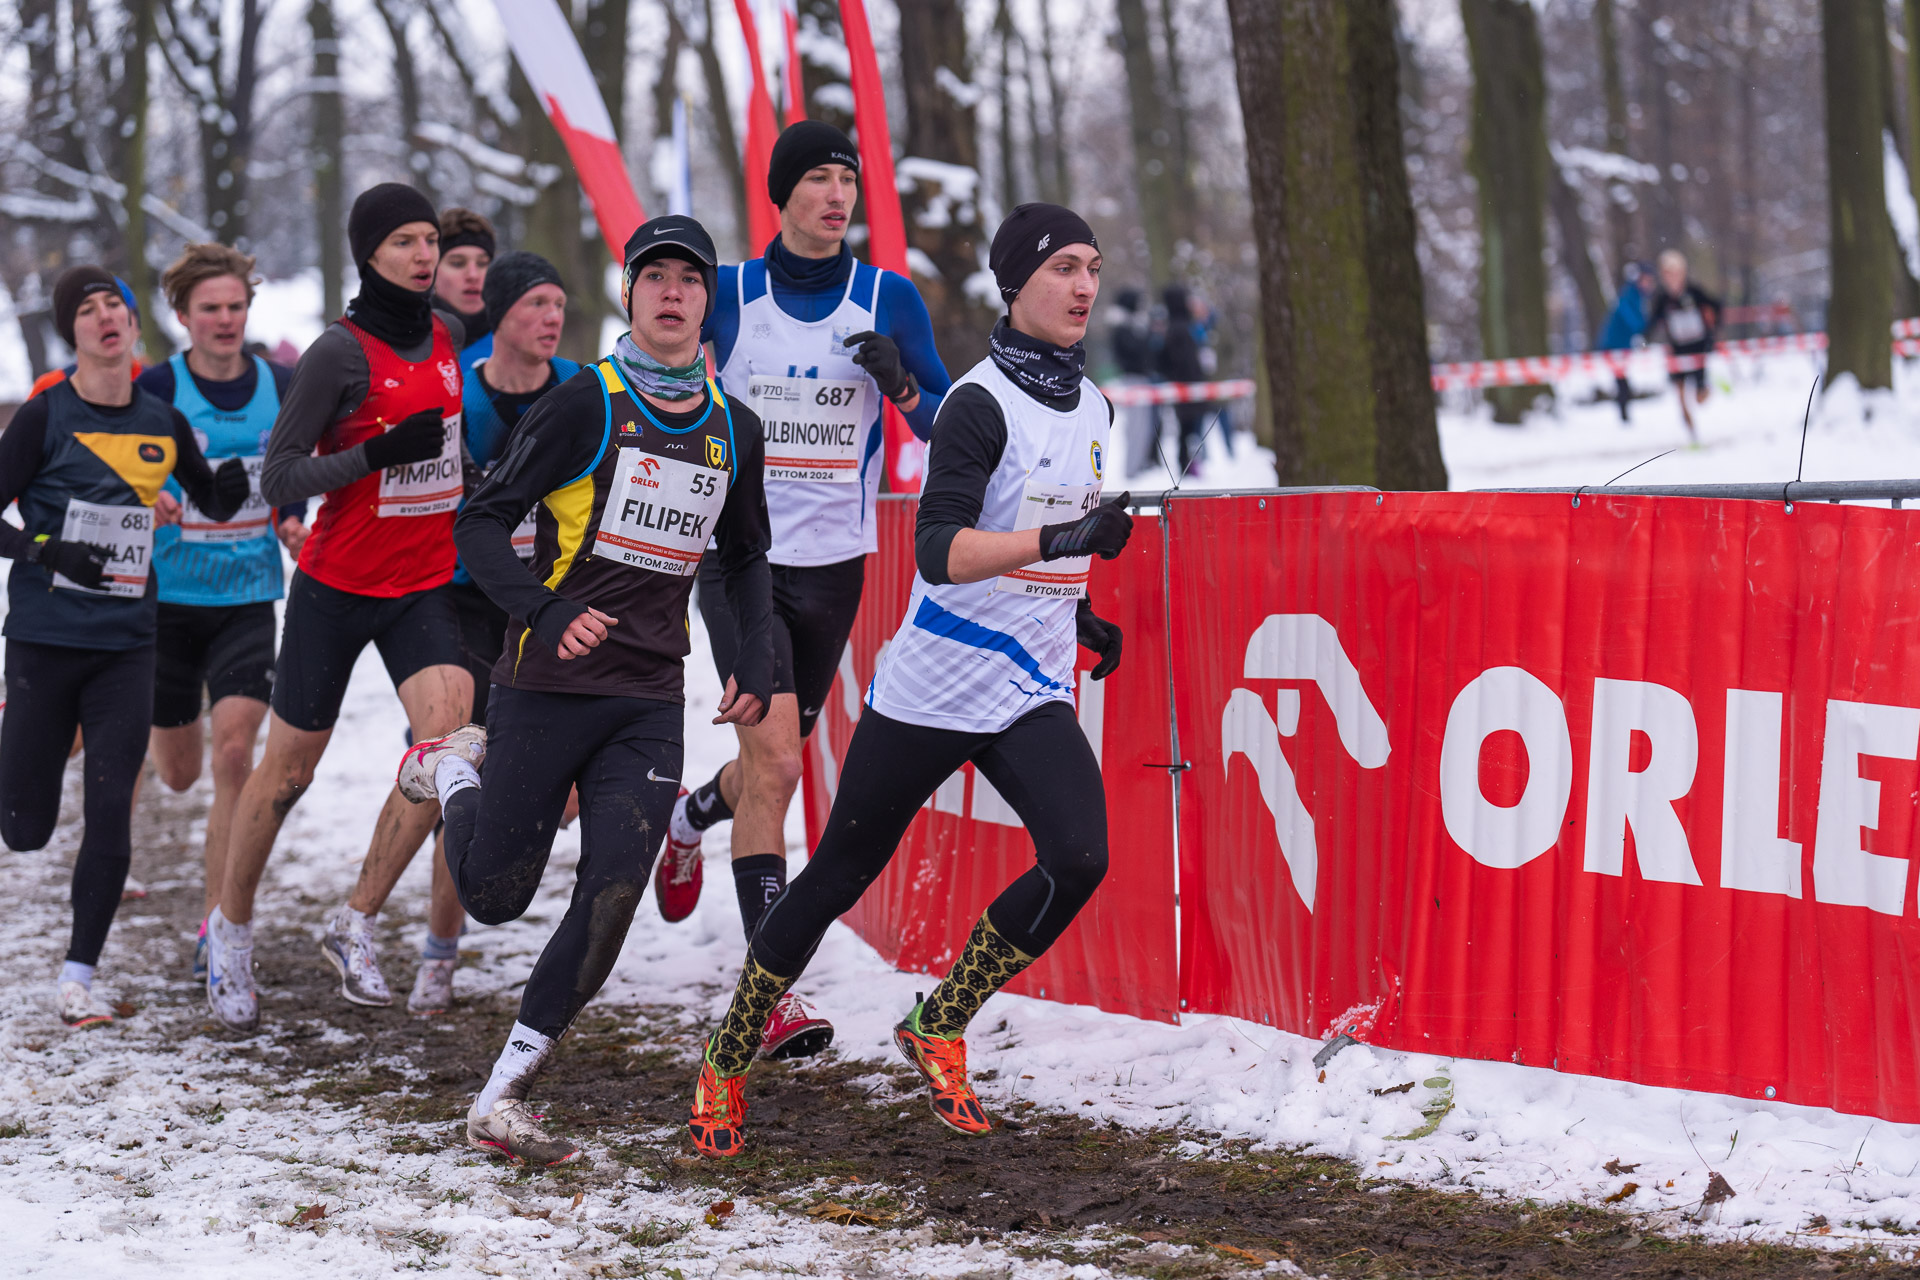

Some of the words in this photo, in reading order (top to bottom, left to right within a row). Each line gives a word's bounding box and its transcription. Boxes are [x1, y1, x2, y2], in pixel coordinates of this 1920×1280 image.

[1004, 346, 1042, 360] atletyka
[763, 384, 783, 396] 770
[815, 386, 857, 407] 687
[770, 469, 807, 479] BYTOM
[809, 471, 834, 480] 2024
[630, 475, 660, 489] ORLEN
[689, 472, 717, 497] 55
[400, 506, 431, 514] BYTOM
[620, 498, 708, 539] FILIPEK
[623, 552, 662, 569] BYTOM
[663, 561, 683, 572] 2024
[1025, 584, 1062, 596] BYTOM
[1062, 586, 1081, 596] 2024
[1439, 665, 1920, 919] ORLE
